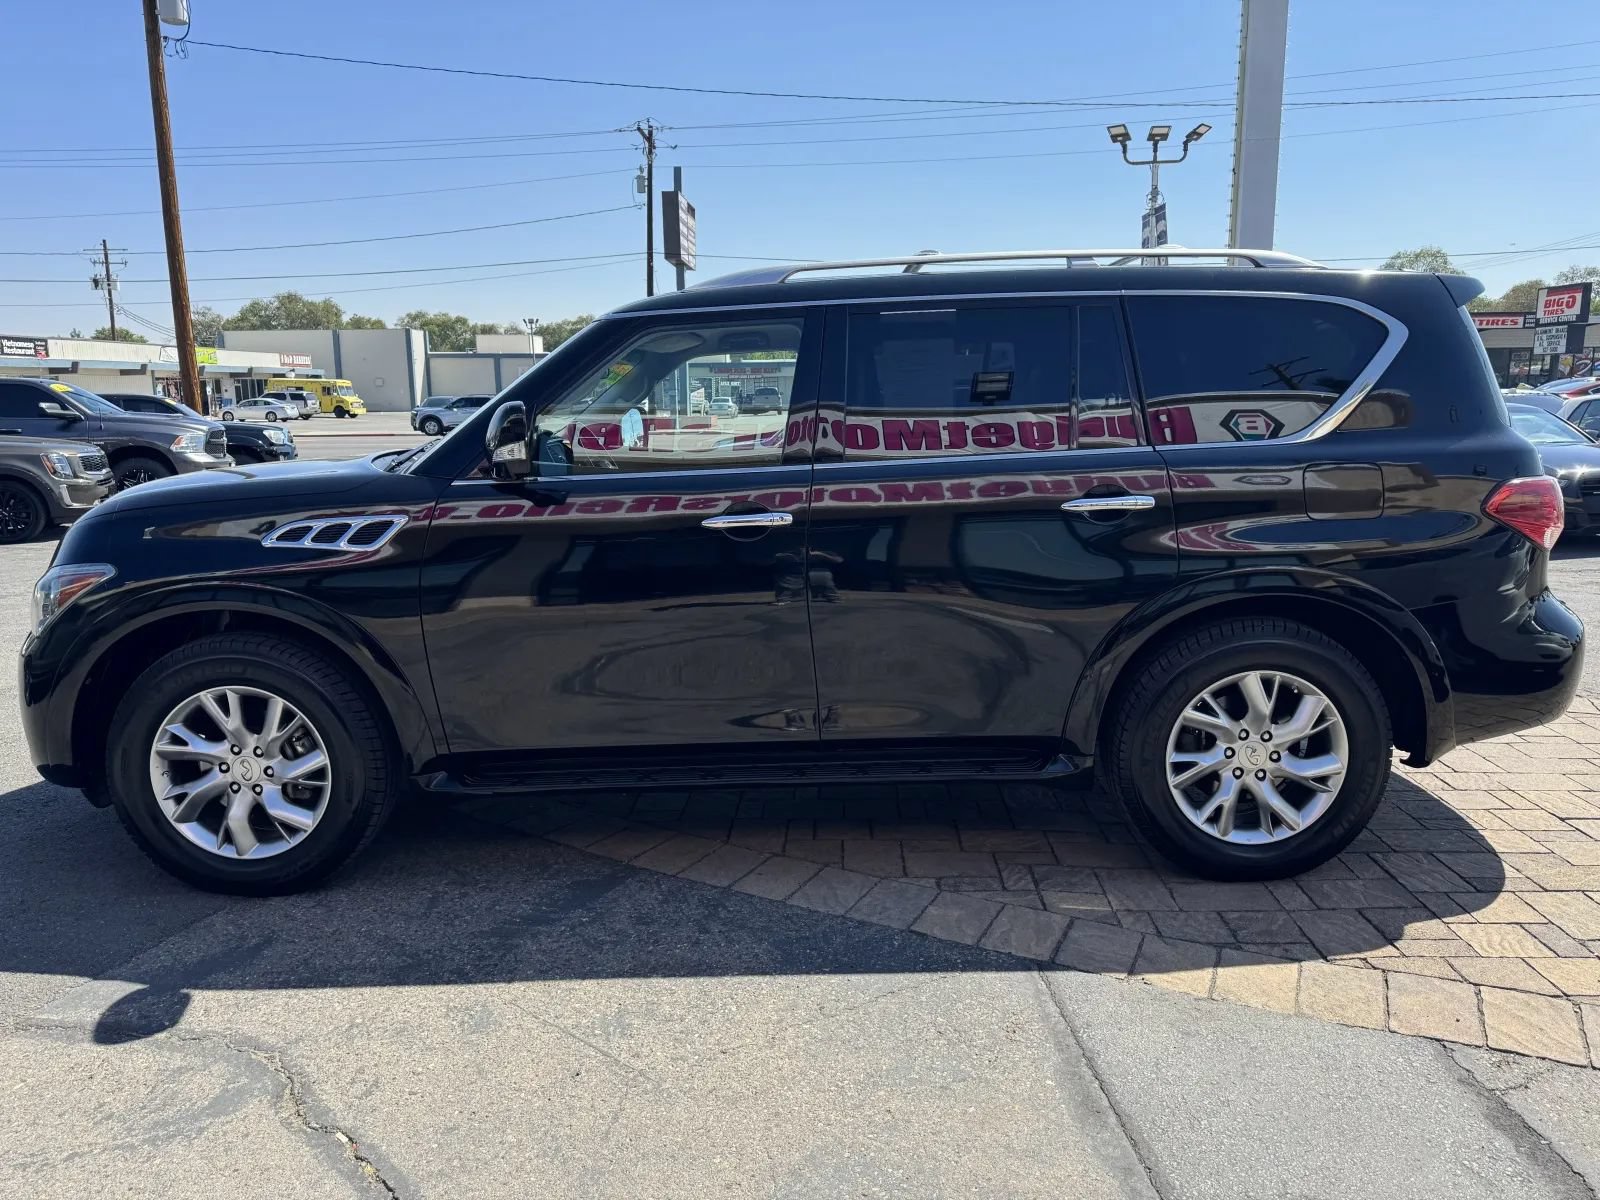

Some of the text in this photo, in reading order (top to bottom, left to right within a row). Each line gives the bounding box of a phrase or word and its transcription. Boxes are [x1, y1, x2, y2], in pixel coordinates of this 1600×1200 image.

[1544, 298, 1565, 309] BIG
[1543, 308, 1564, 316] TIRES
[2, 339, 34, 348] Vietnamese
[4, 346, 35, 355] Restaurant
